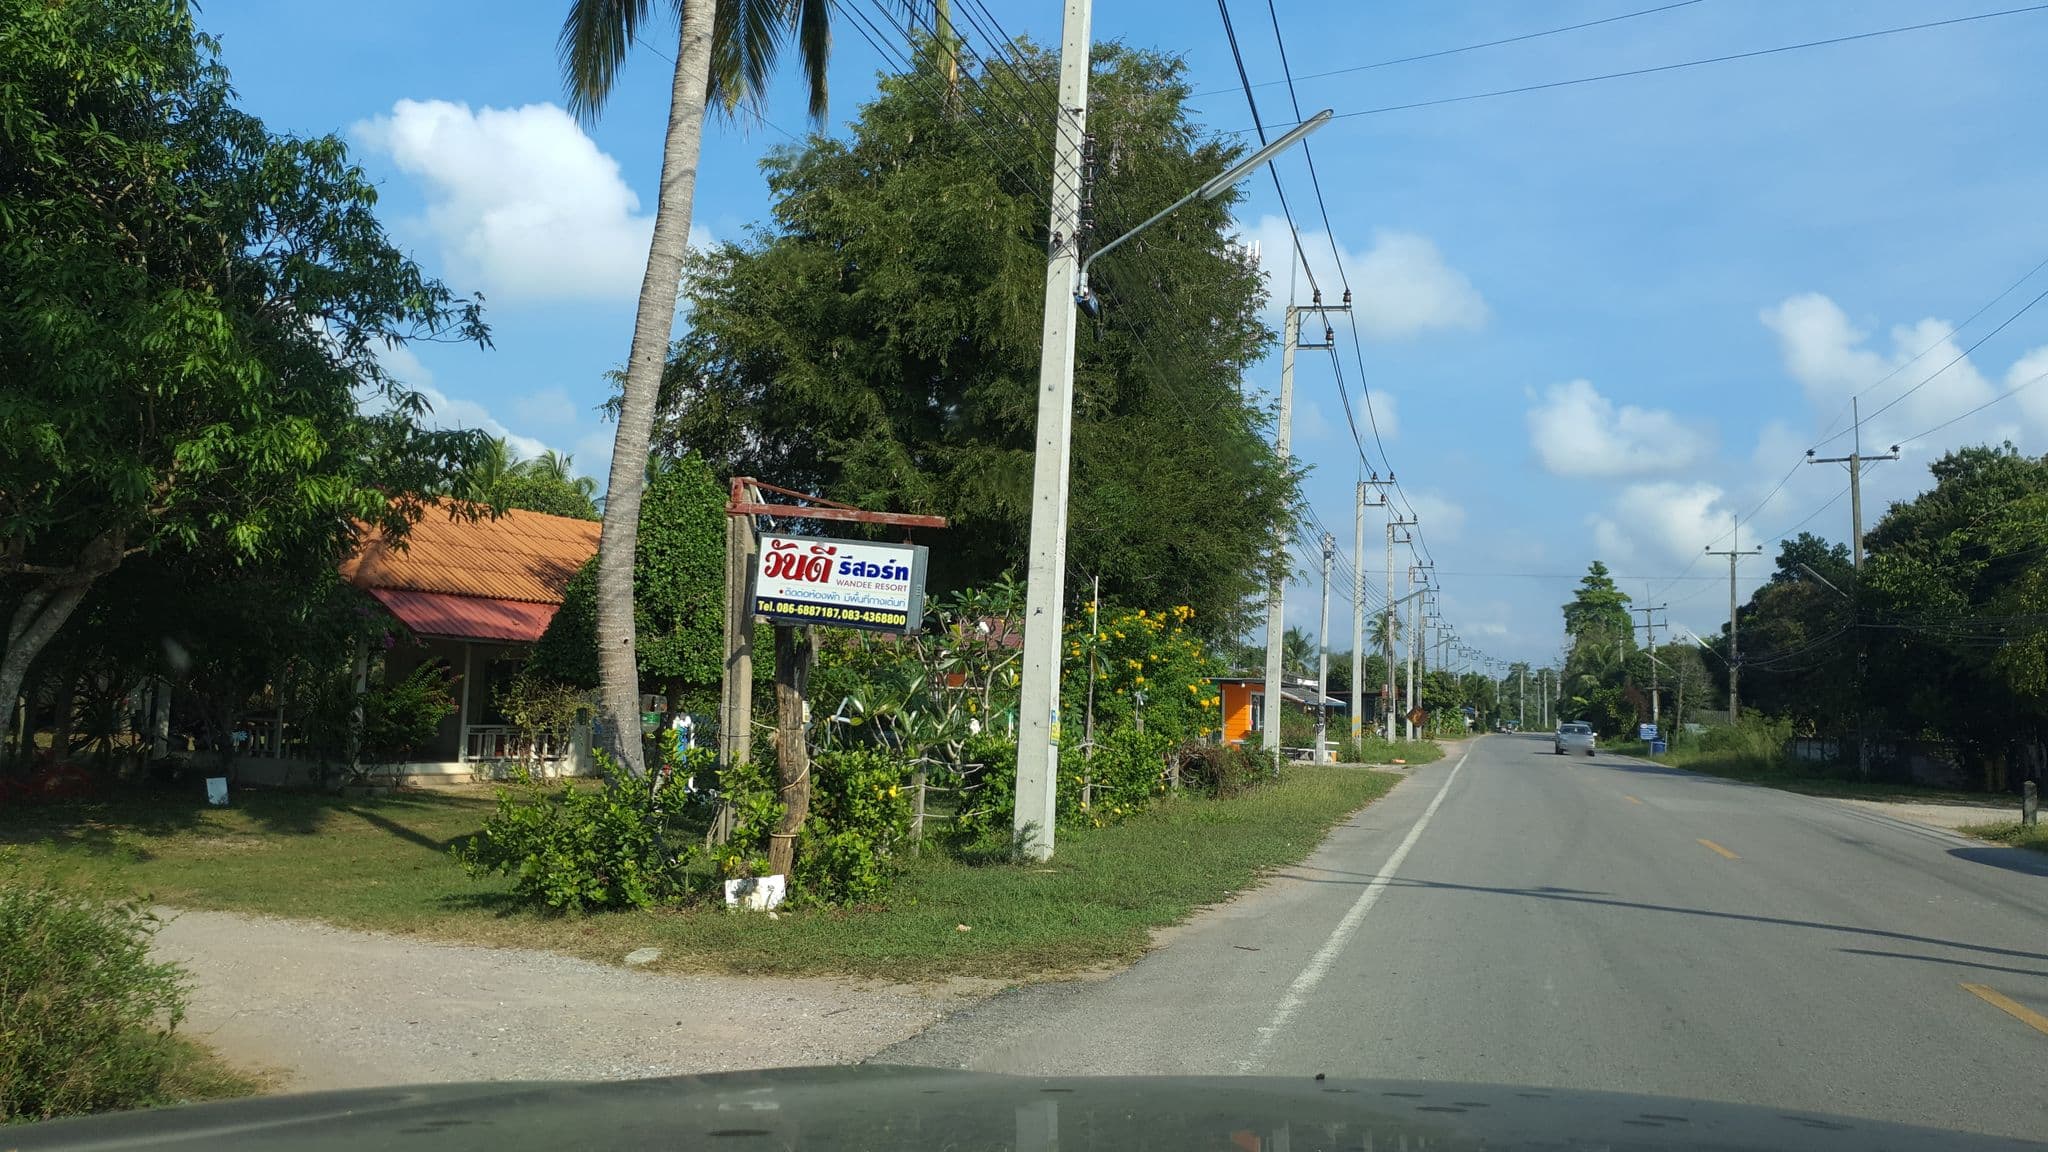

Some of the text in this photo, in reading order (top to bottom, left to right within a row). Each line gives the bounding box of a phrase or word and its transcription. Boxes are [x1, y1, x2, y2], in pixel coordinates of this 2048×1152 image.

[764, 539, 909, 583] วันดี รีสอร์ท
[836, 579, 908, 592] WANDEE RESORT
[758, 600, 775, 612] Tel.
